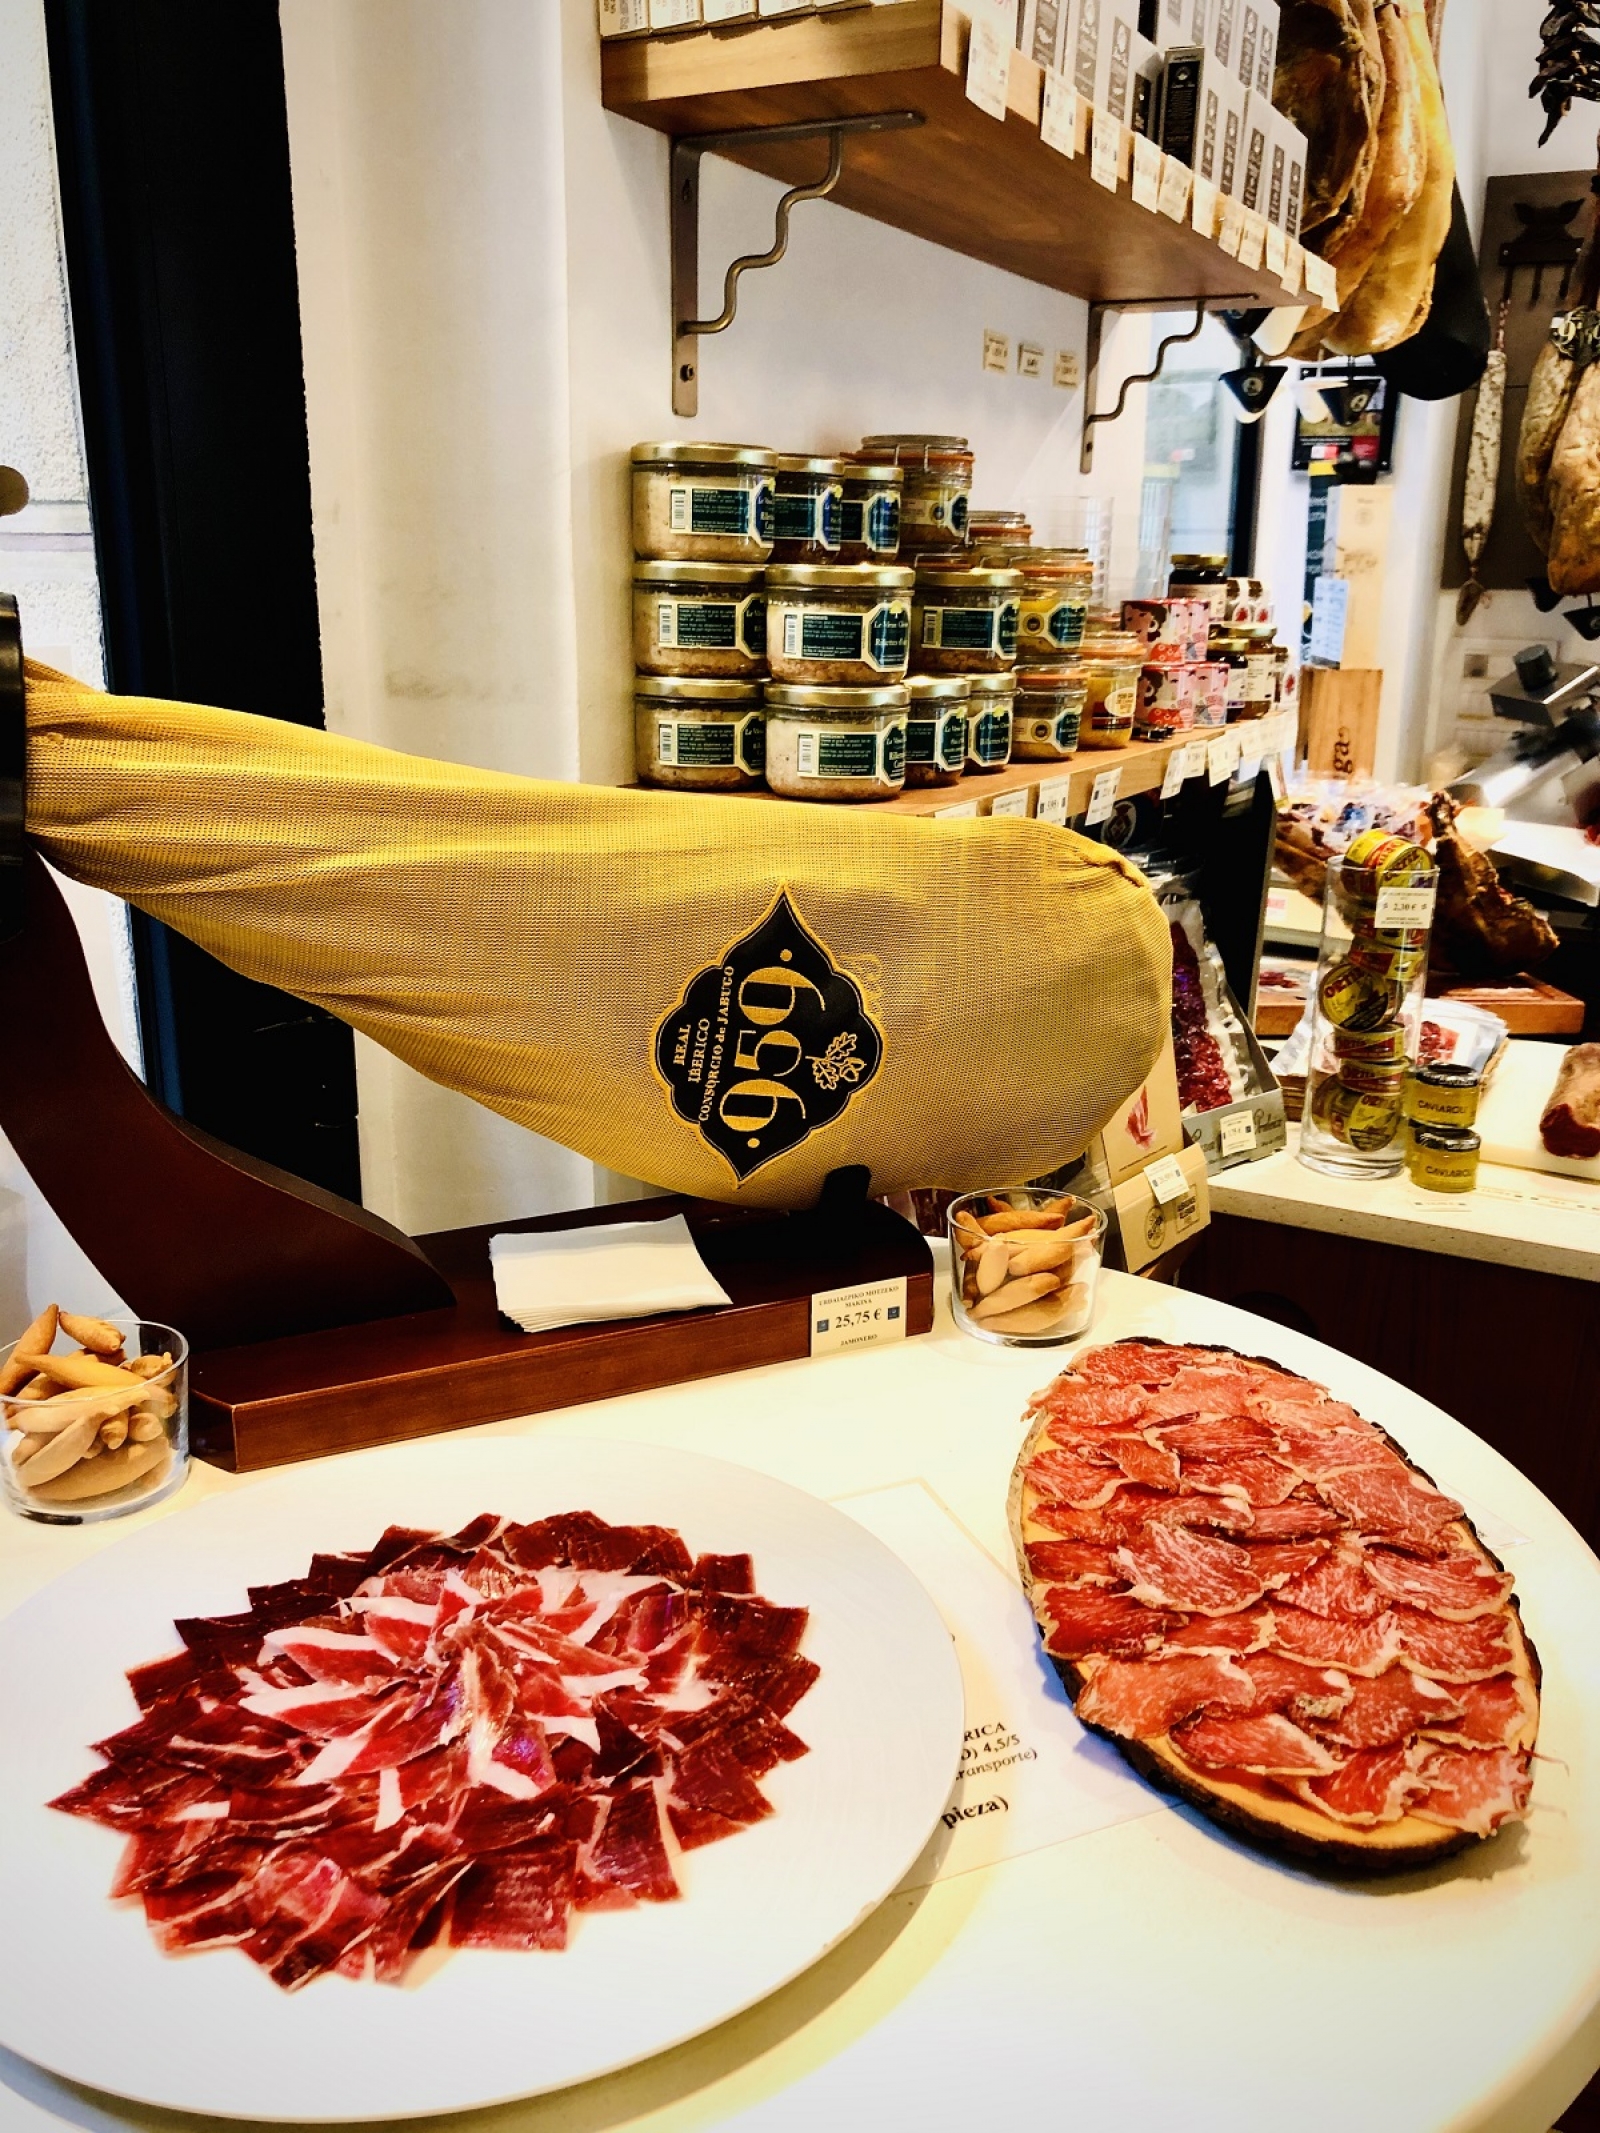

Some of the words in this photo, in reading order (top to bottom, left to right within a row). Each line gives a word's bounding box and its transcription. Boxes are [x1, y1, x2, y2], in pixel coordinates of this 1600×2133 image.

[718, 965, 735, 1025] JABUGO
[673, 1024, 692, 1066] REAL
[688, 1018, 710, 1083] IBERICO
[715, 1025, 726, 1043] de
[719, 966, 826, 1132] 959
[699, 1043, 724, 1122] CONSORCIO
[835, 1310, 870, 1329] 25,75
[873, 1308, 882, 1321] €
[840, 1334, 878, 1346] JAMONERO
[983, 1733, 1021, 1753] 4,5/5
[955, 1747, 1038, 1781] ransporte)
[941, 1794, 1009, 1830] pieza)
